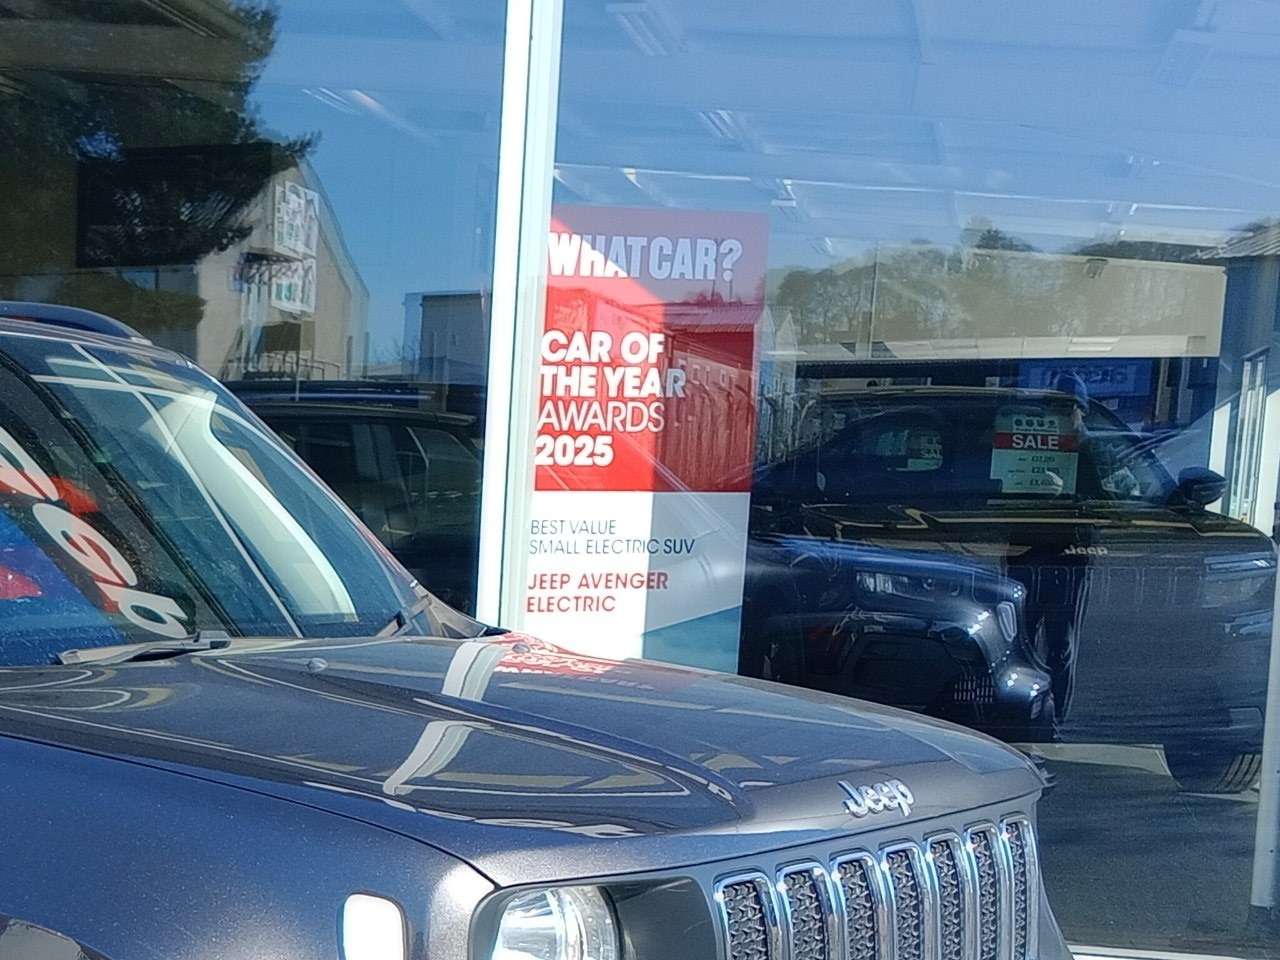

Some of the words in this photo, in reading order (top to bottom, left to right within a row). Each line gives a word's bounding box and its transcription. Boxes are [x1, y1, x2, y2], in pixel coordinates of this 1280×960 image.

[548, 231, 648, 278] WHAT
[649, 236, 743, 282] CAR?
[541, 330, 612, 362] CAR
[620, 331, 665, 364] OF
[540, 365, 598, 397] THE
[603, 366, 687, 398] YEAR
[536, 400, 665, 432] AWARDS
[535, 434, 614, 466] 2025
[1011, 434, 1059, 450] SALE
[530, 519, 565, 535] BEST
[569, 519, 617, 535] VALUE
[529, 539, 579, 555] SMALL
[586, 539, 659, 555] ELECTRIC
[663, 538, 696, 555] SUV
[528, 573, 571, 590] JEEP
[577, 572, 668, 590] AVENGER
[526, 596, 616, 613] ELECTRIC
[837, 778, 915, 817] Jeep
